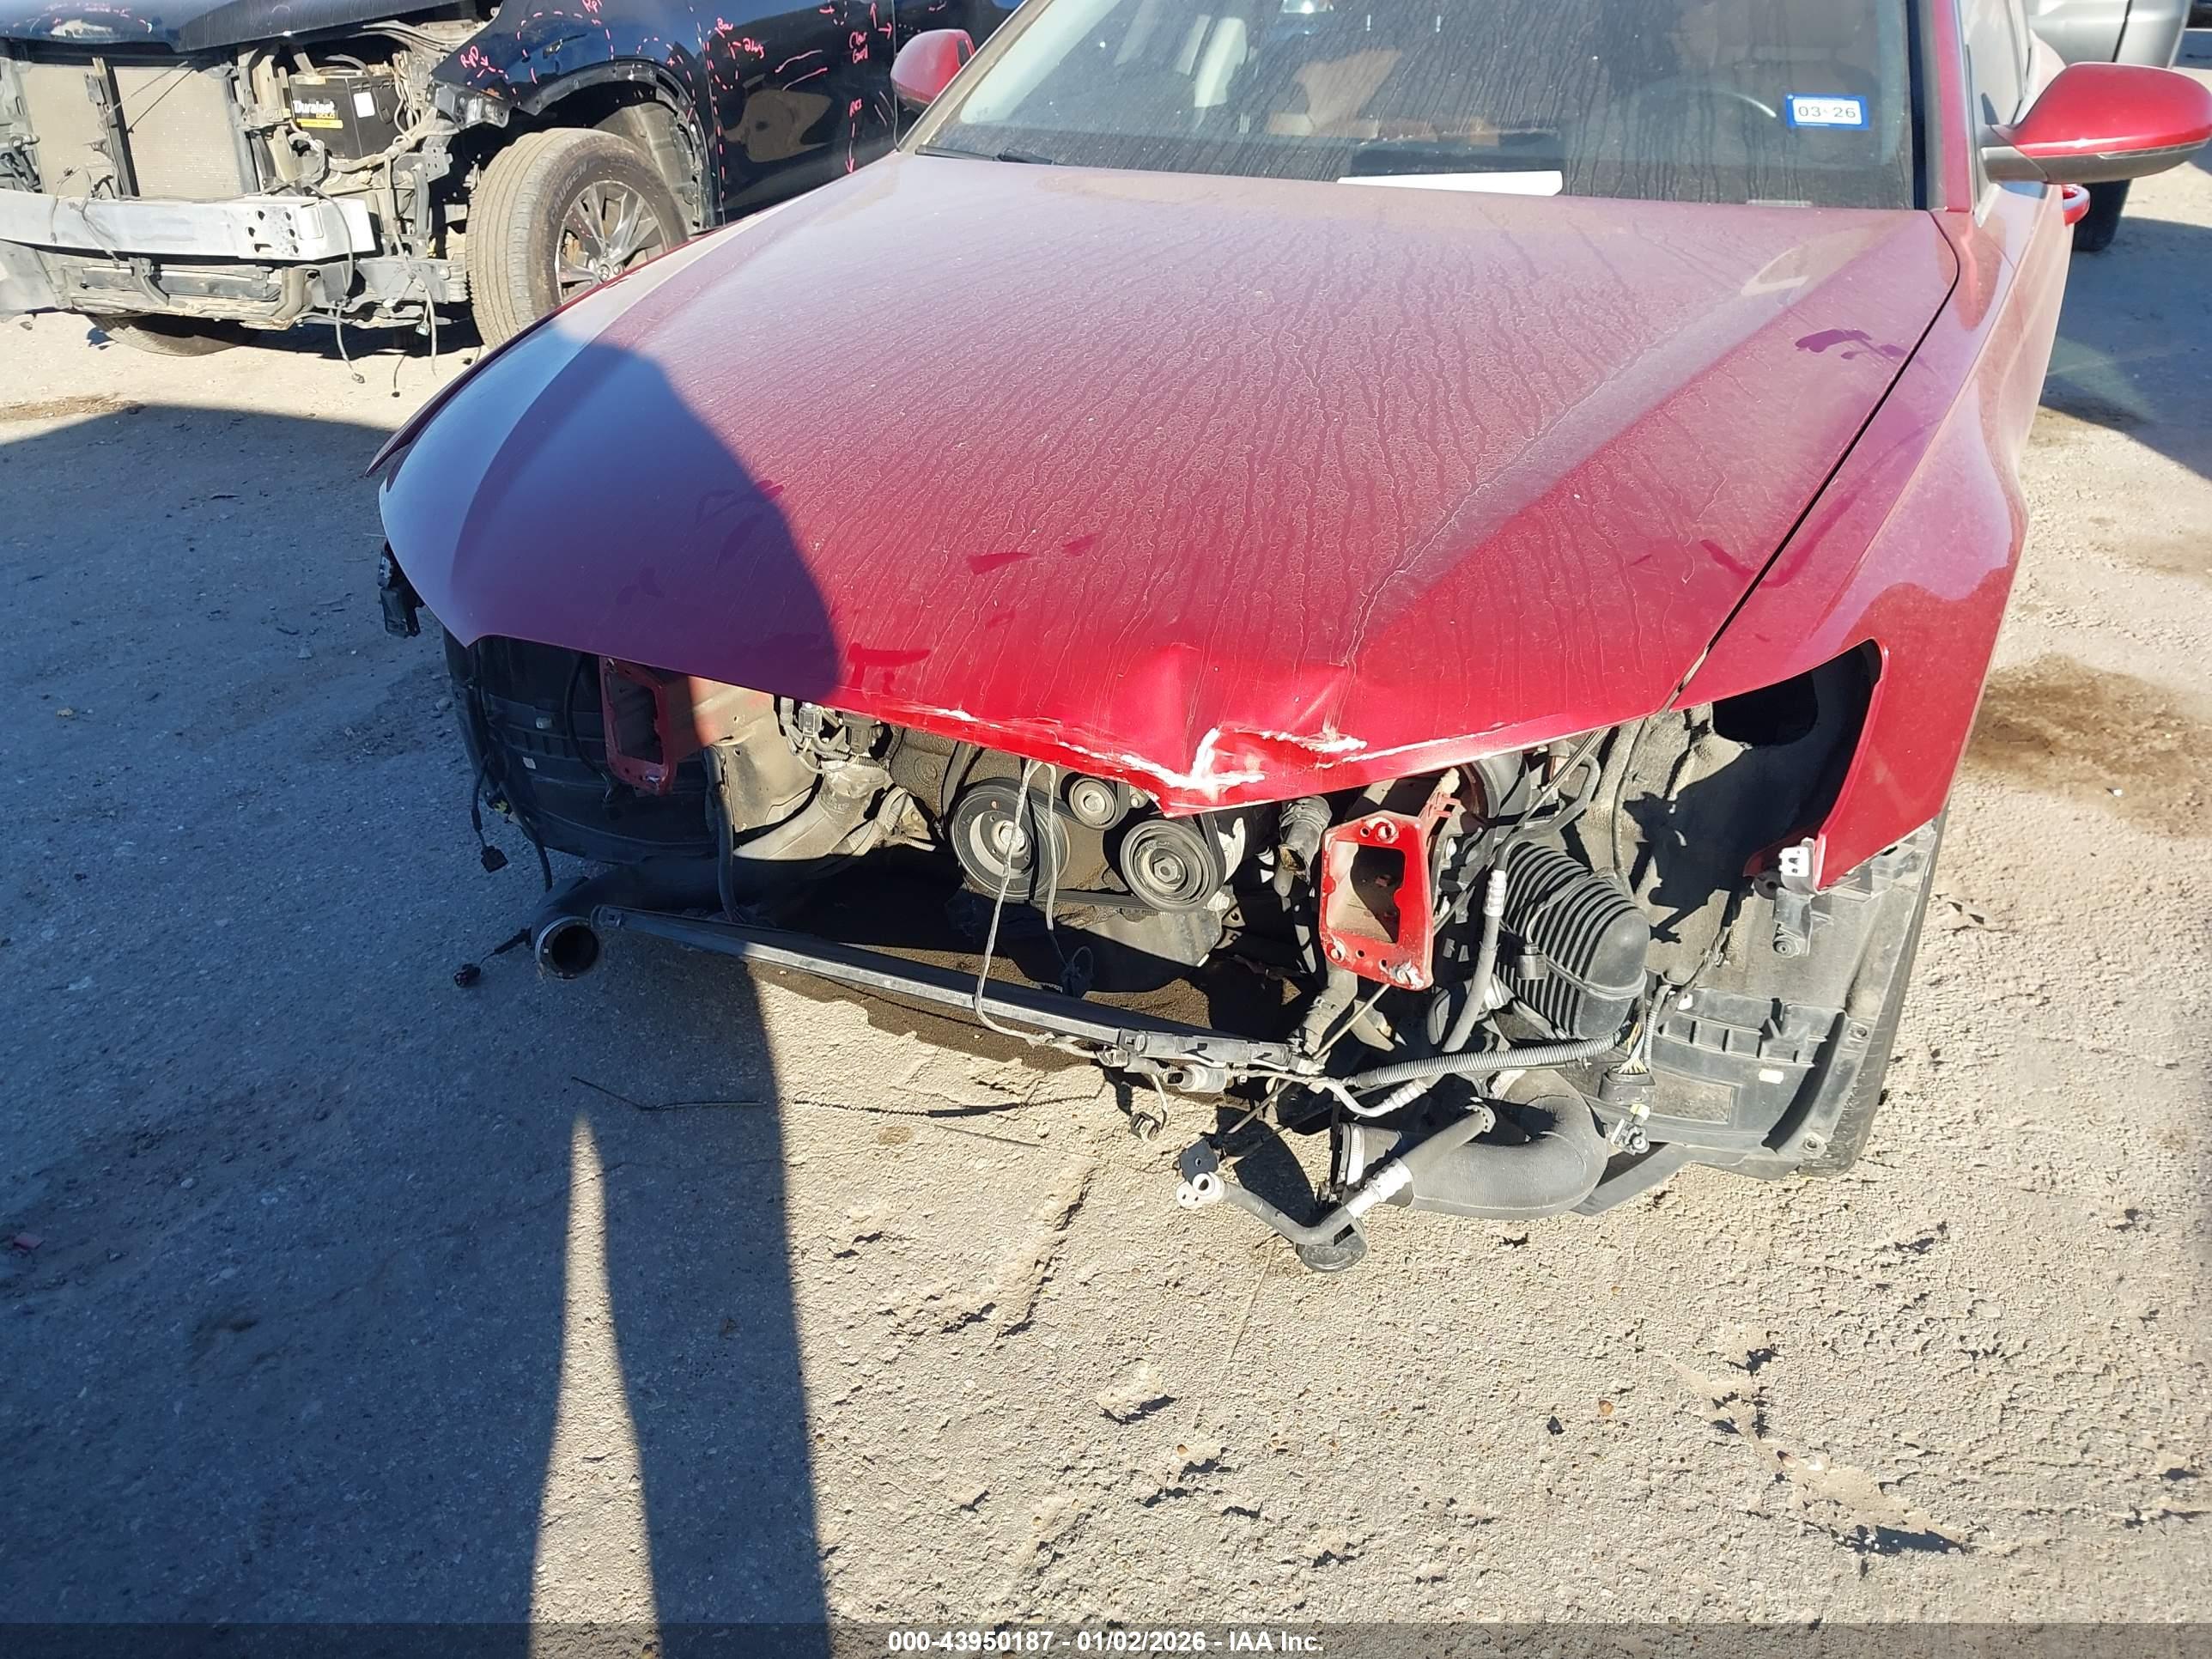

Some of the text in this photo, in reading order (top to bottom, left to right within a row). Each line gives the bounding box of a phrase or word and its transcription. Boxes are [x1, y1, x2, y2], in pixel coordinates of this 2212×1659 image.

[293, 99, 336, 114] Duralast
[1798, 106, 1856, 118] 03 26
